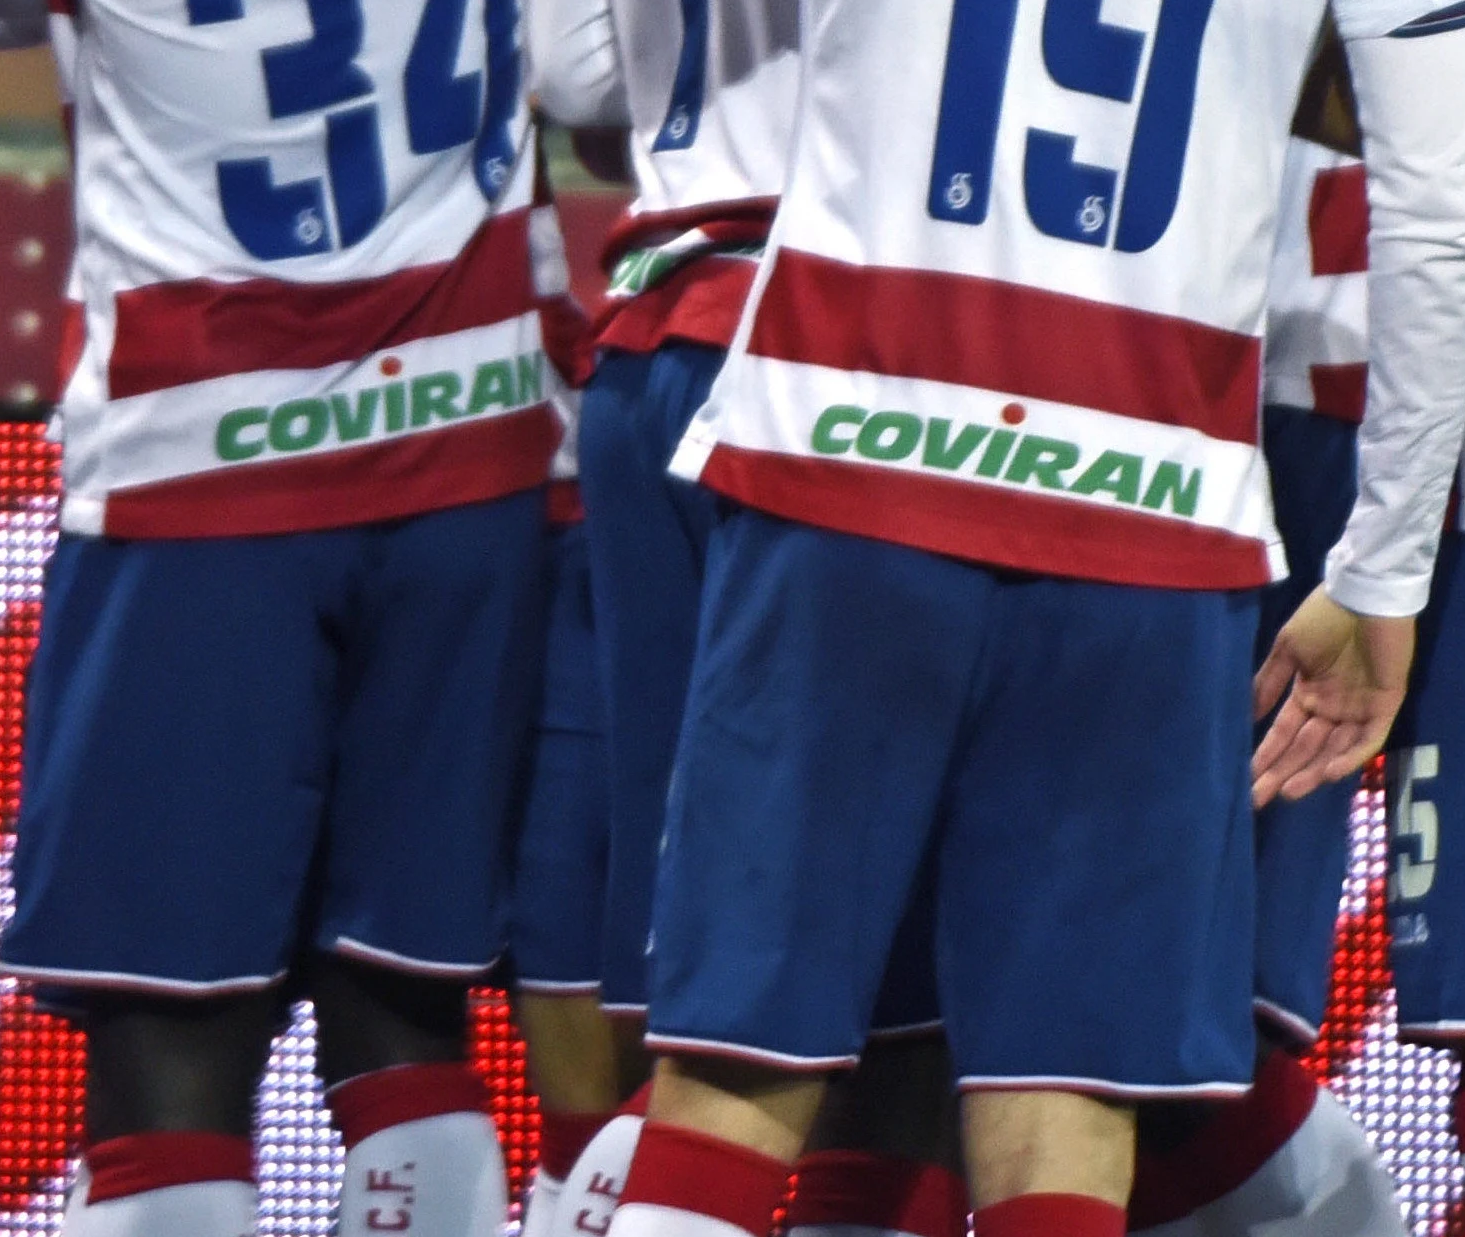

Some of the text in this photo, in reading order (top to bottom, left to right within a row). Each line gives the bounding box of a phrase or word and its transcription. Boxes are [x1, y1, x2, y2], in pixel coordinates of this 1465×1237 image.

[214, 348, 544, 462] COVIRAN
[810, 401, 1202, 518] COVIRAN
[1388, 743, 1439, 901] 5
